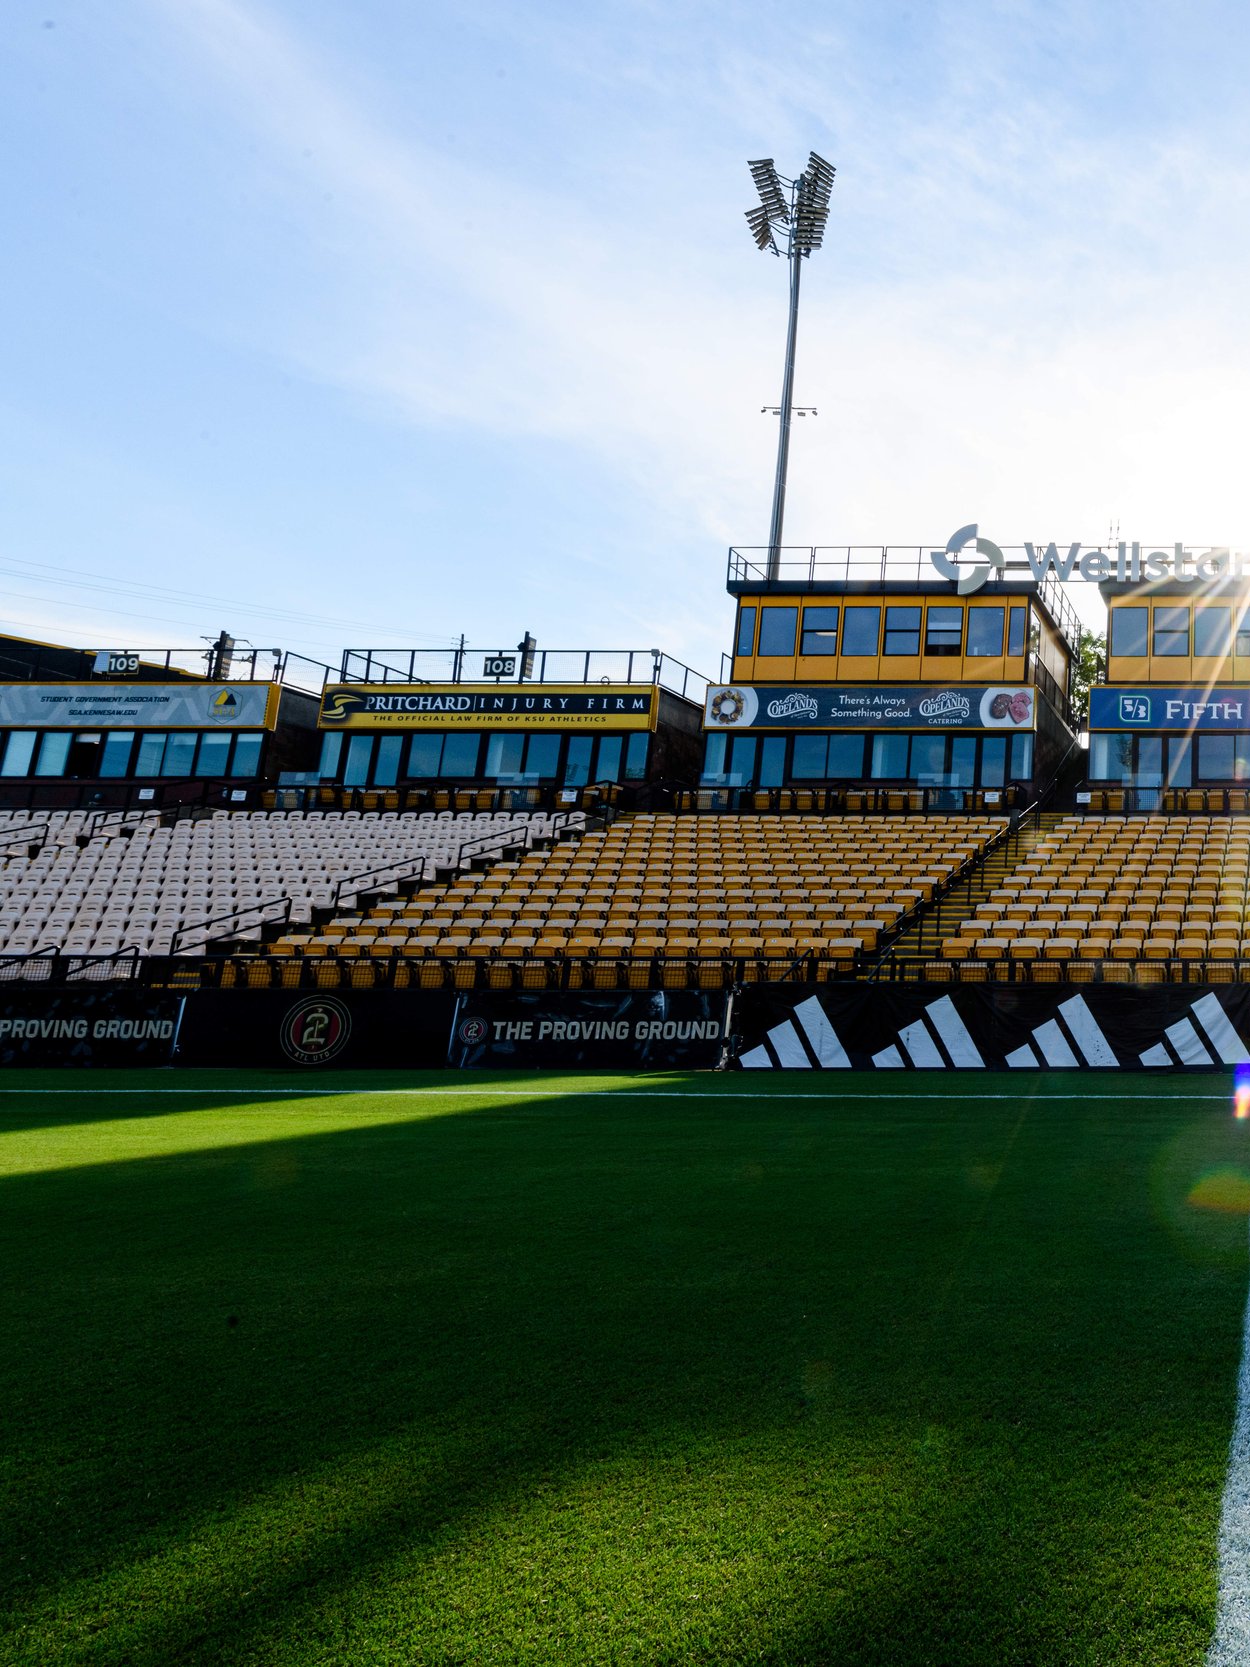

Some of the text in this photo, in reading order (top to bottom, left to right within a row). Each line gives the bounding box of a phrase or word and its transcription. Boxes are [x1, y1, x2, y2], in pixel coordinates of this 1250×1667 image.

[110, 658, 138, 671] 109
[485, 660, 514, 674] 108
[364, 696, 645, 711] PRITCHARD INJURY FIRM
[839, 695, 906, 707] There's Always
[830, 708, 913, 719] Something Good.
[1165, 700, 1242, 719] FIFTH
[0, 1020, 173, 1039] PROVING GROUND
[493, 1021, 720, 1040] THE PROVING GROUND
